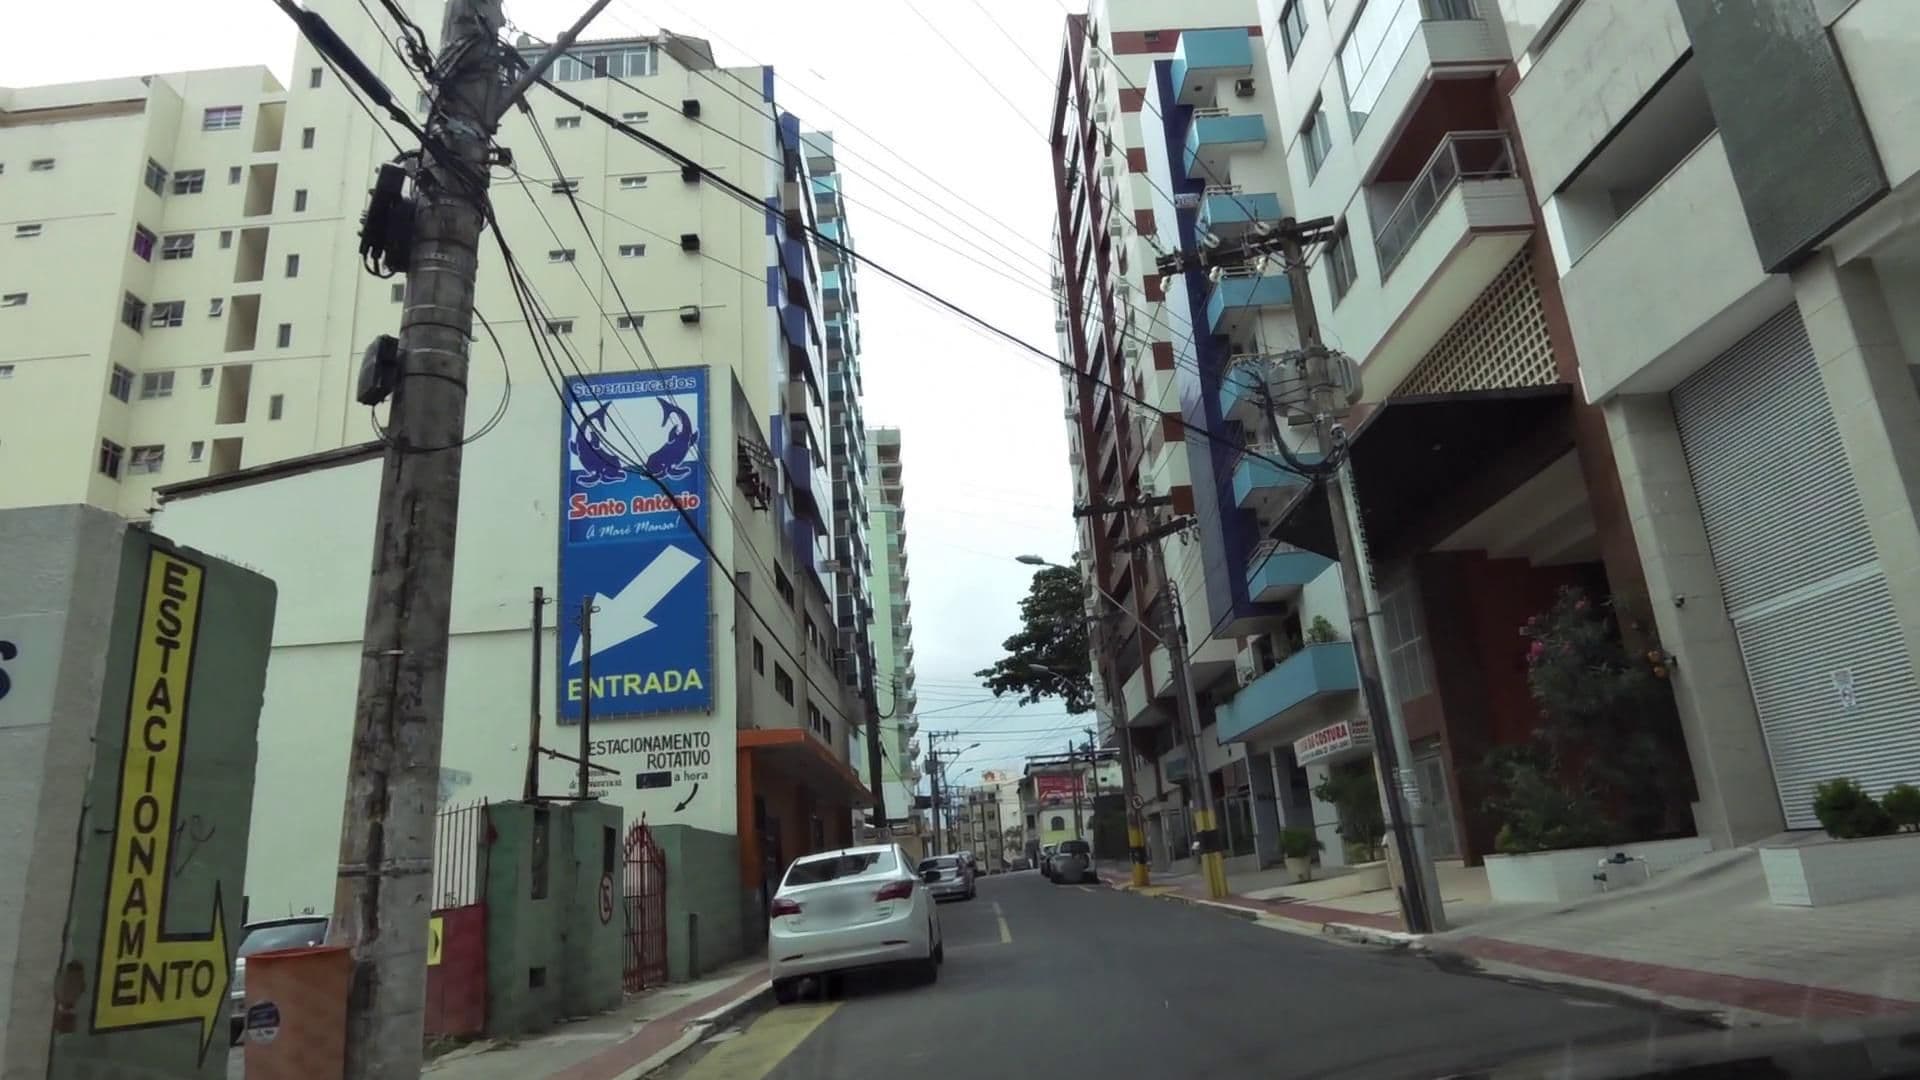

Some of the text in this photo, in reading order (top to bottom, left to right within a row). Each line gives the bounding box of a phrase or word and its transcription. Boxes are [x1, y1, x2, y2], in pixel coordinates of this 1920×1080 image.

[573, 376, 696, 398] Supermercados
[569, 493, 627, 519] Santo
[568, 669, 703, 701] ENTRADA
[588, 731, 710, 756] ESTACIONAMENTO
[1315, 724, 1348, 745] COSTURA
[647, 750, 710, 769] ROTATIVO
[110, 561, 215, 1007] ESTACIONAMENTO
[683, 770, 709, 781] hora
